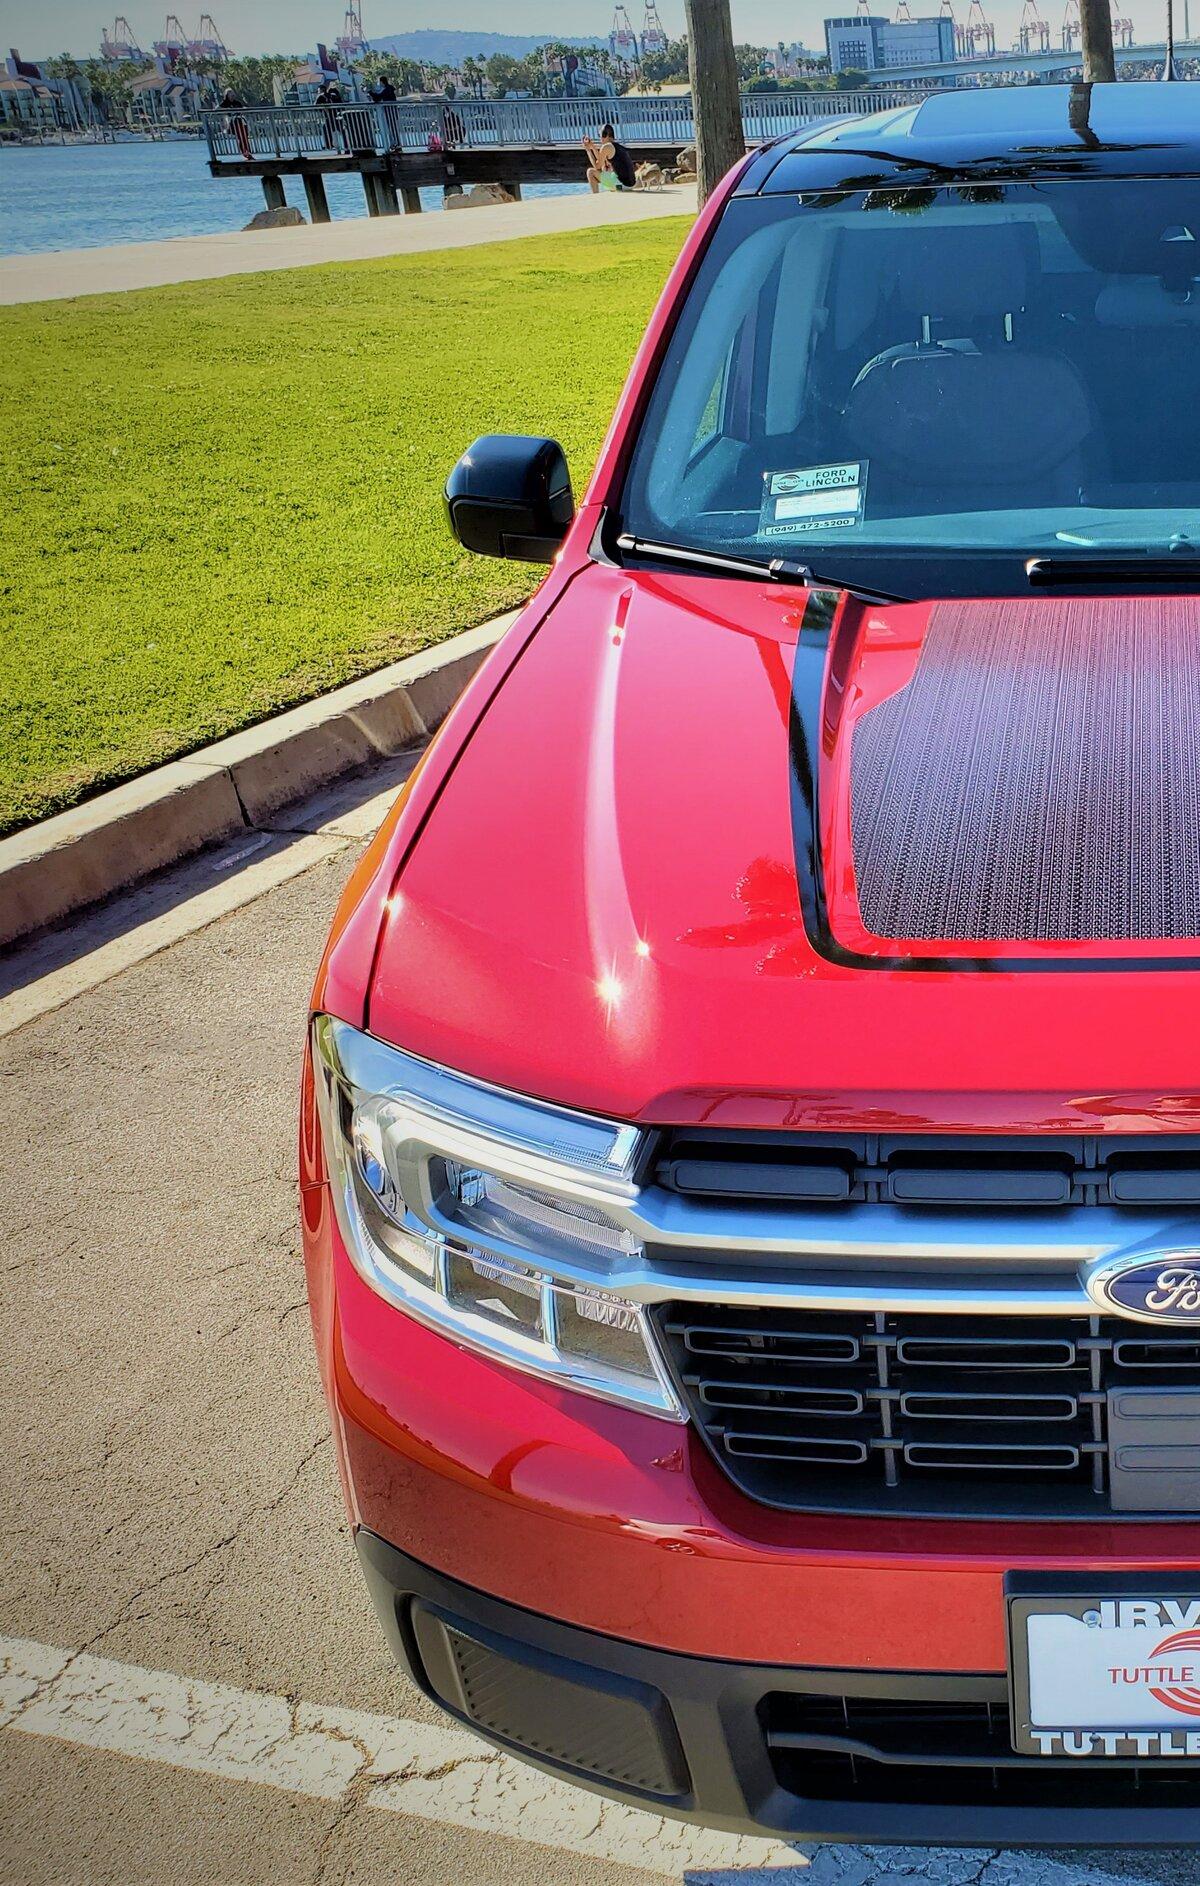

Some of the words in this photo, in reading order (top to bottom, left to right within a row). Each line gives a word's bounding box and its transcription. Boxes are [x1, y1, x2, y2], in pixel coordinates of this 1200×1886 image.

[815, 469, 847, 479] FORD
[805, 475, 856, 488] LINCOLN
[770, 525, 797, 535] (949)
[800, 519, 850, 530] 472-5200
[1107, 1666, 1195, 1685] TUTTLE
